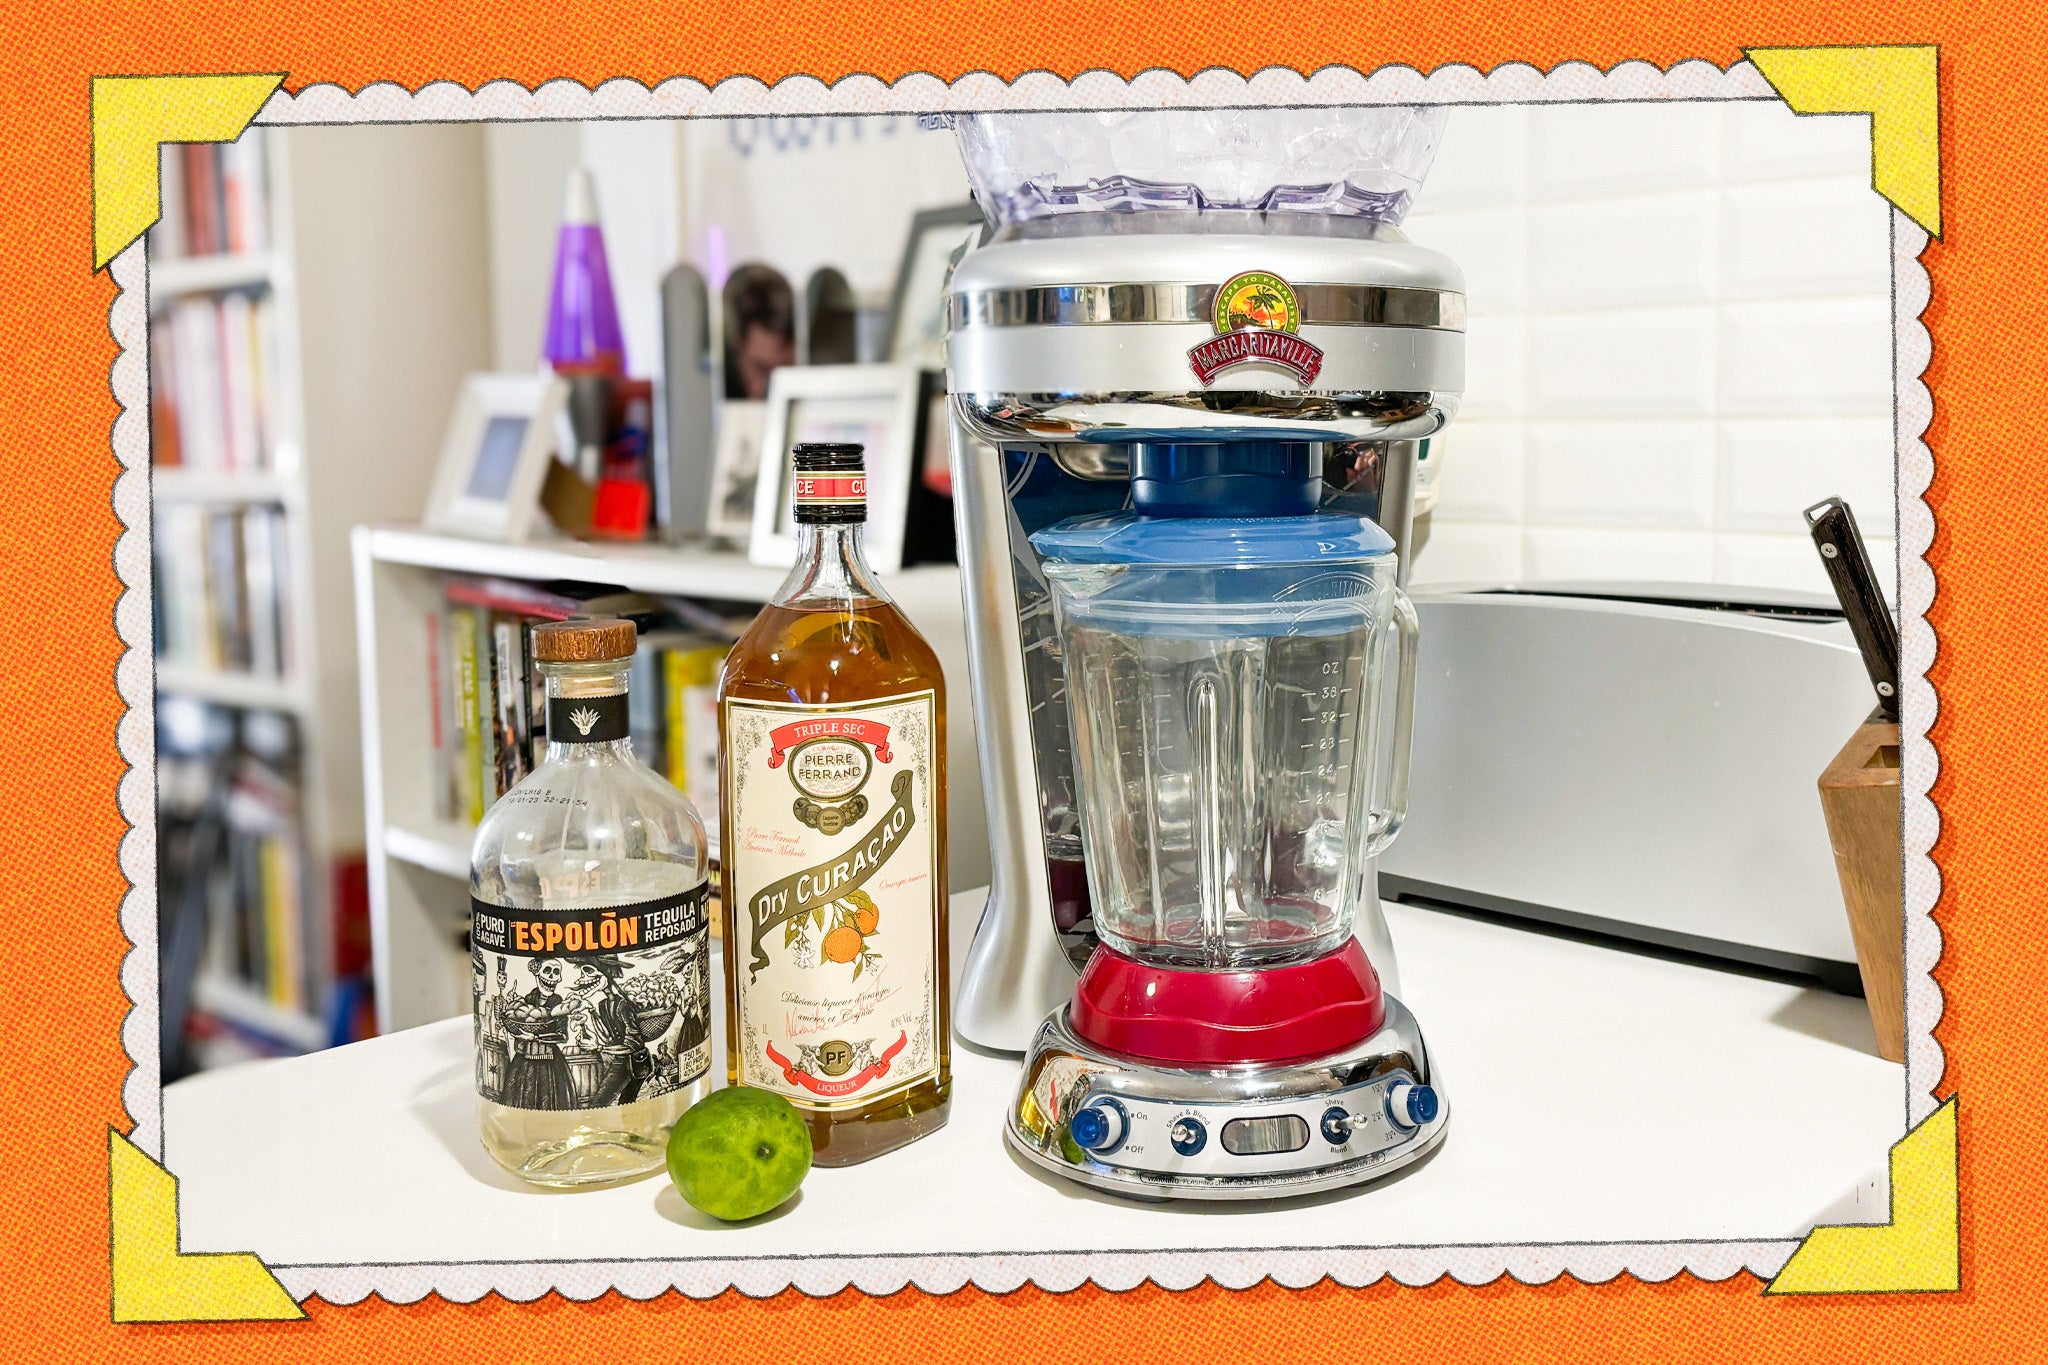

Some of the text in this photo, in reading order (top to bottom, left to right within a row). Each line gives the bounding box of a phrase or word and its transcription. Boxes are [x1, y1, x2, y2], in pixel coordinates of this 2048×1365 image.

[1220, 276, 1295, 324] ESCAPE TO PARADISE
[1194, 333, 1319, 372] MARGARITAVILLE
[1322, 661, 1339, 675] OZ
[1320, 710, 1337, 724] 32
[793, 722, 866, 738] TRIPLE SEC
[805, 753, 854, 766] PIERRE
[799, 766, 861, 781] FERRAND
[758, 806, 907, 927] Dry CURAÇAO
[643, 901, 696, 929] TEQUILA
[480, 913, 505, 935] PURO
[645, 916, 696, 943] REPOSADO
[480, 930, 506, 948] AGAVE
[827, 1015, 836, 1023] et
[826, 1051, 846, 1065] PF
[816, 1080, 857, 1093] LIQUEUR
[1136, 1112, 1148, 1121] On
[1166, 1111, 1184, 1129] Shave
[1130, 1145, 1144, 1154] Off
